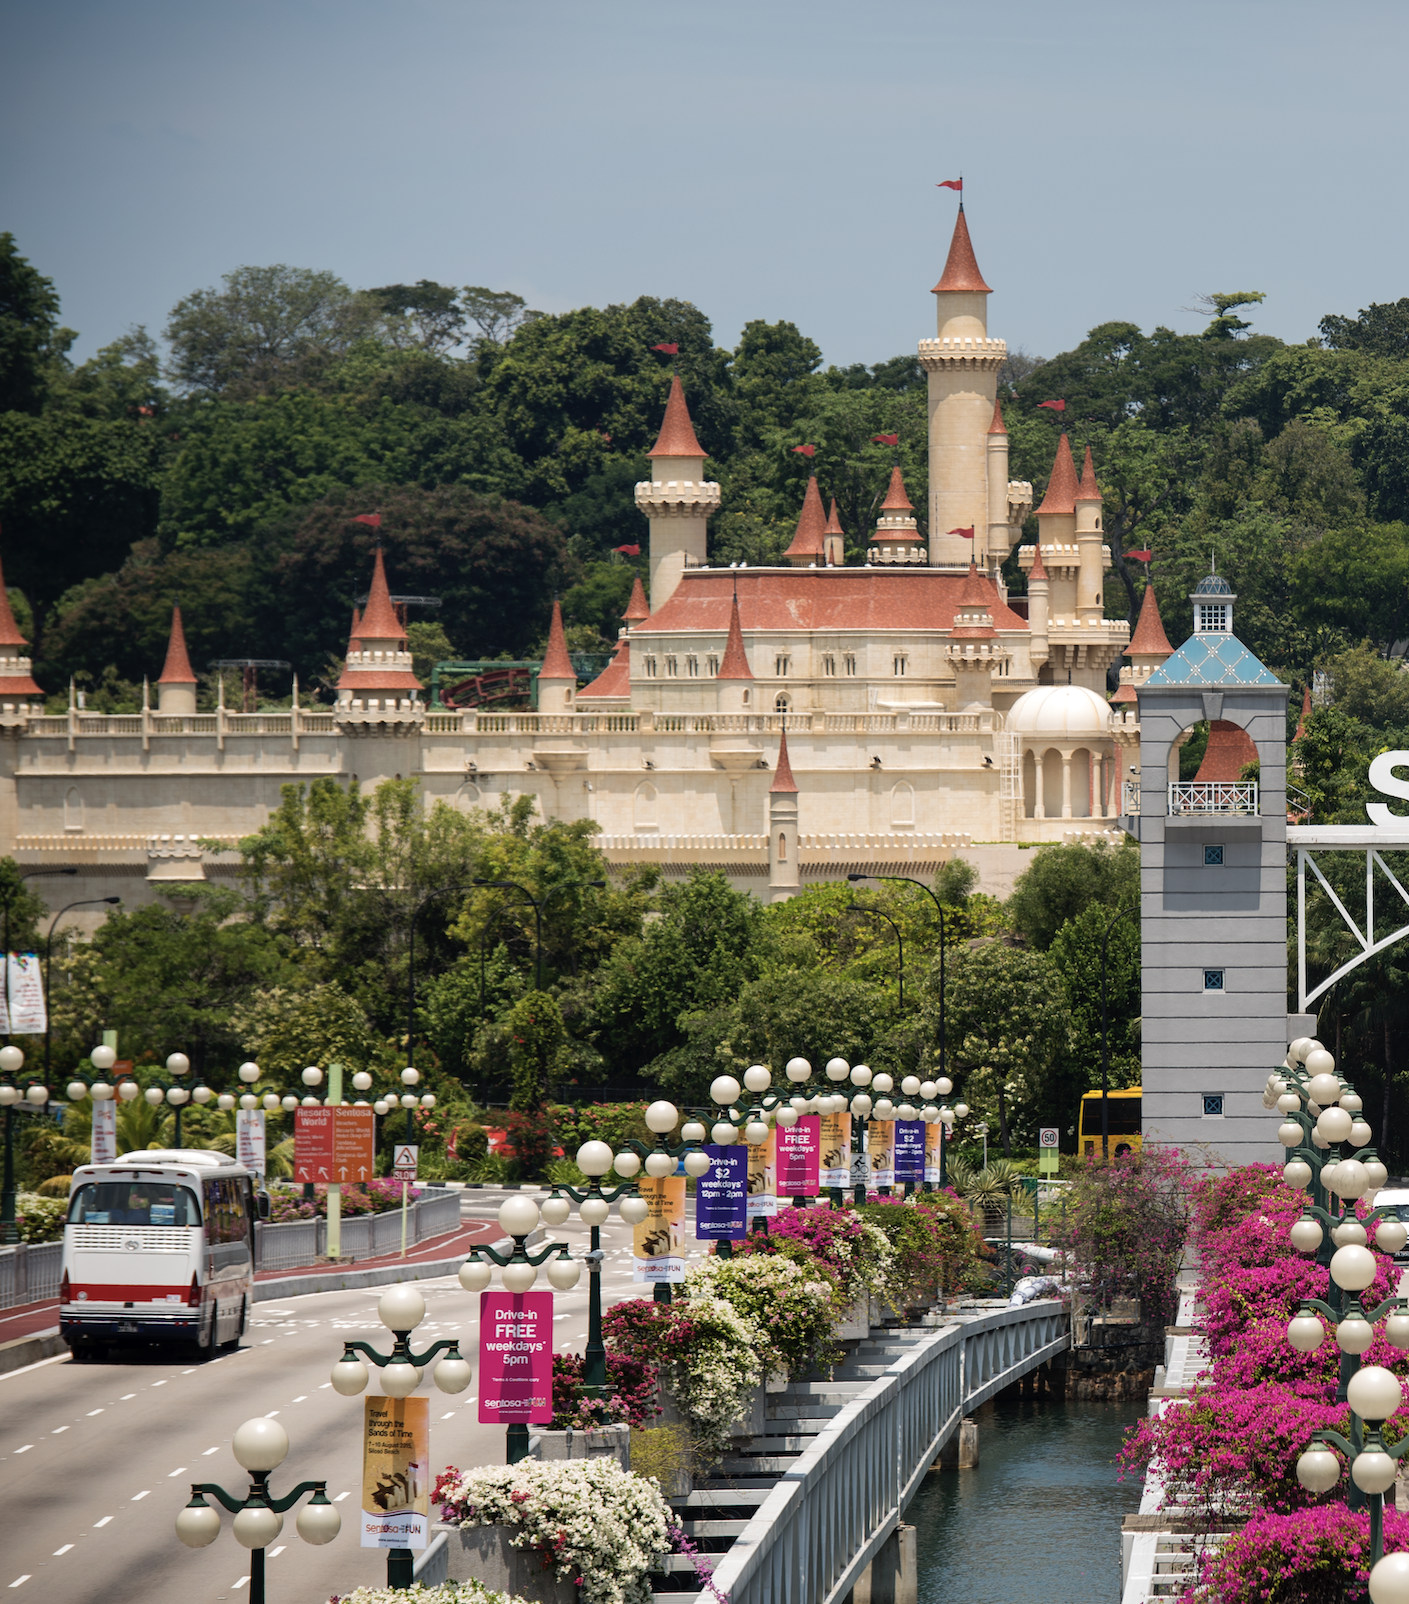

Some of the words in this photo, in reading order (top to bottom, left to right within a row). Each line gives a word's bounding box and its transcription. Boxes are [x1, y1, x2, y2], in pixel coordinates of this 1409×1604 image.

[296, 1108, 331, 1117] Resorts
[336, 1108, 372, 1117] Sentosa
[301, 1117, 327, 1126] World
[784, 1135, 810, 1144] FREE
[1045, 1134, 1054, 1142] 50
[709, 1158, 738, 1166] Drive-in
[394, 1172, 416, 1180] SLOW
[715, 1167, 730, 1179] $2
[701, 1190, 720, 1198] 12pm
[726, 1190, 743, 1198] 2pm
[495, 1310, 537, 1320] Drive-in
[495, 1324, 536, 1338] FREE
[503, 1354, 528, 1366] 5pm
[484, 1399, 521, 1408] sentosa
[369, 1420, 393, 1429] through
[397, 1430, 413, 1438] Time
[366, 1524, 399, 1534] sentosa
